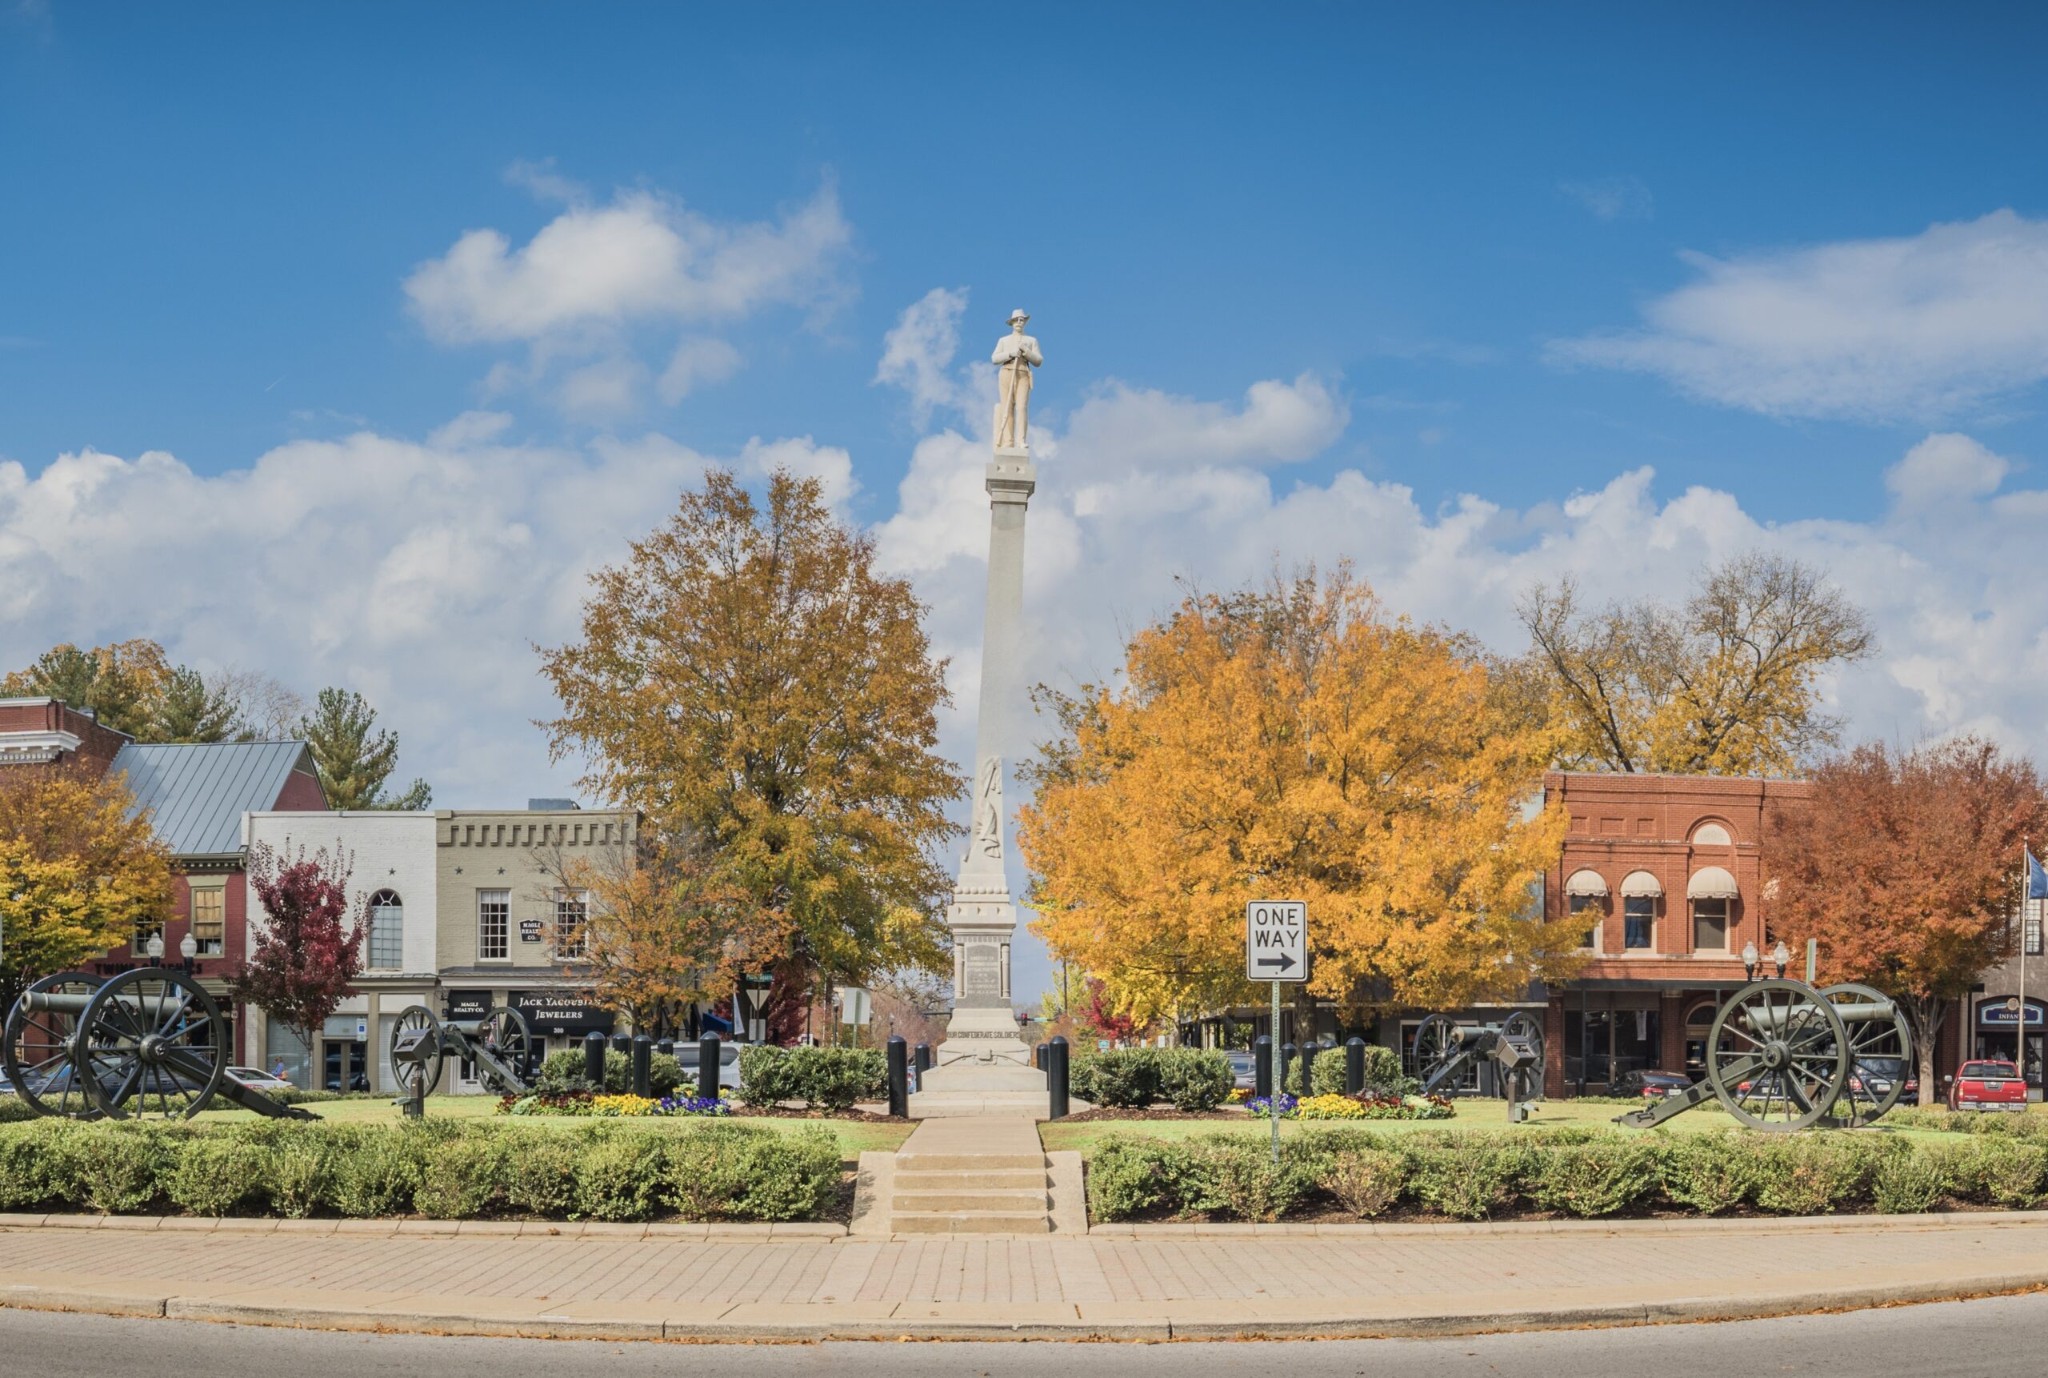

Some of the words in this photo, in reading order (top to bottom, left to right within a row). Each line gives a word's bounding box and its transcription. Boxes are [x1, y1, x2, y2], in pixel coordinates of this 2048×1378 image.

[1256, 908, 1298, 925] ONE
[1256, 930, 1299, 947] WAY
[957, 1031, 993, 1039] CONFEDERATE
